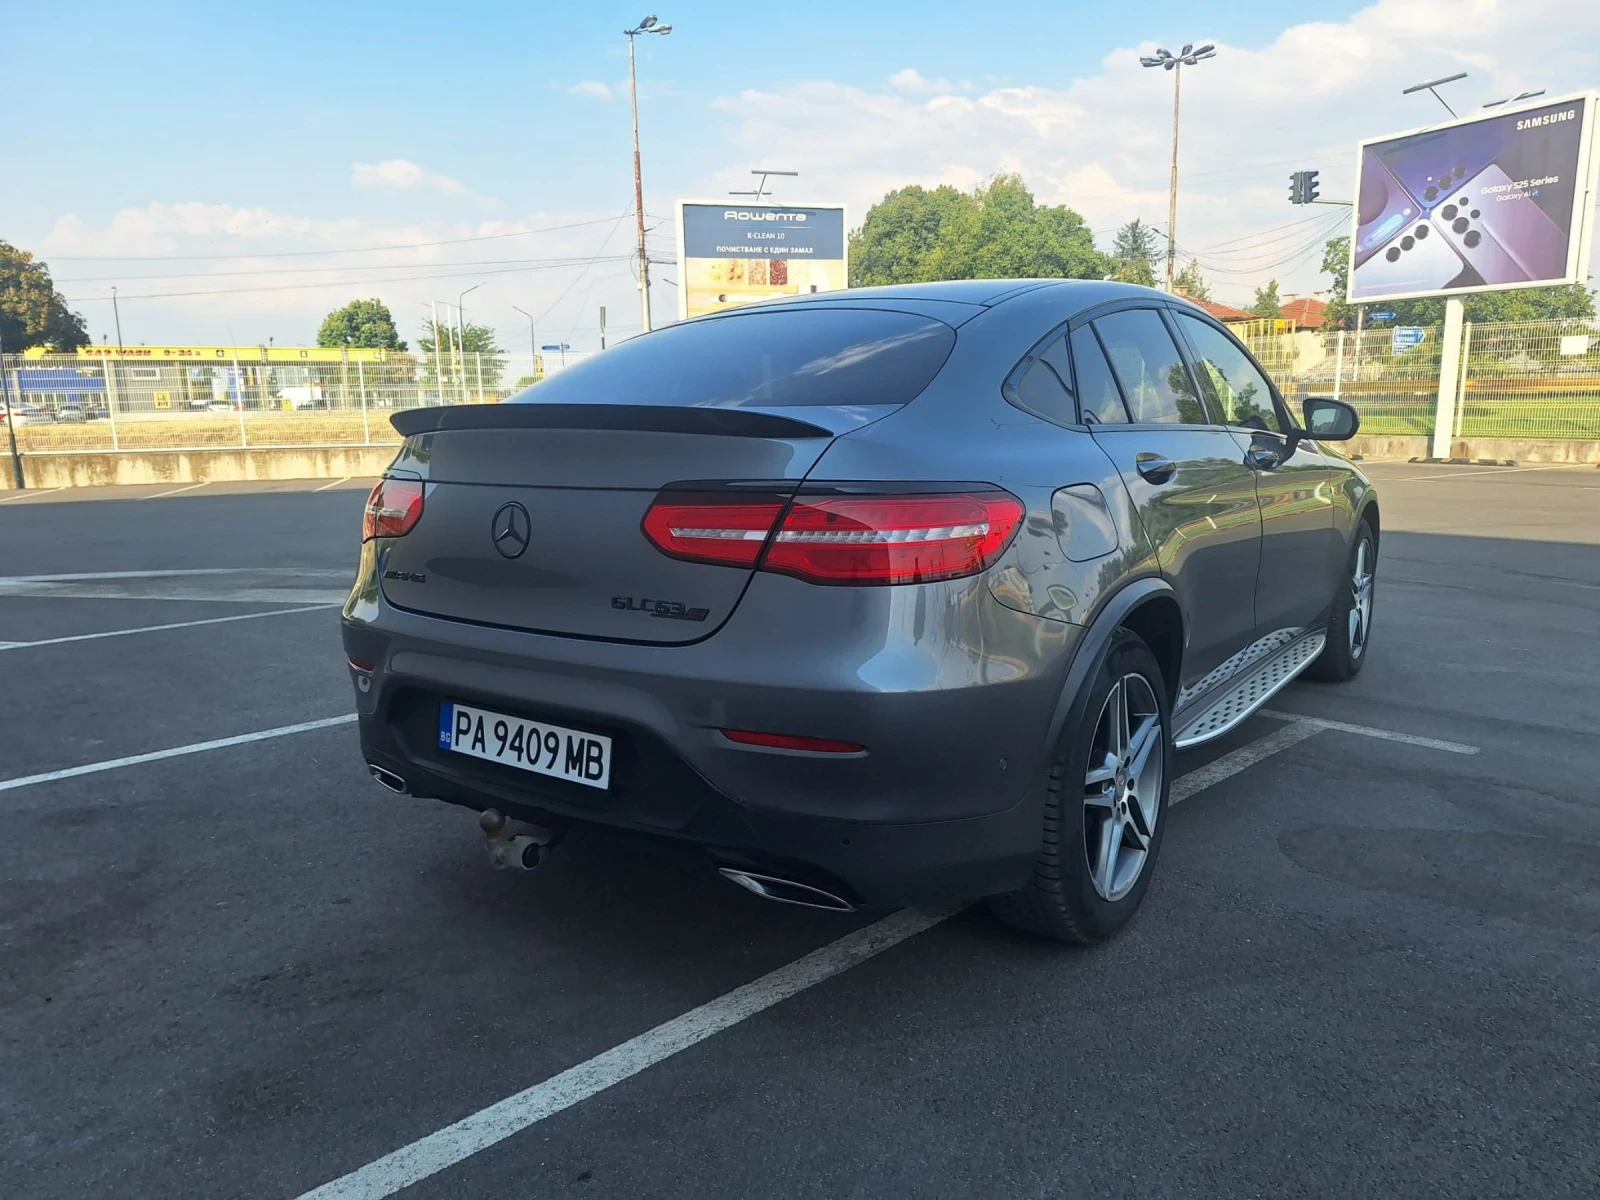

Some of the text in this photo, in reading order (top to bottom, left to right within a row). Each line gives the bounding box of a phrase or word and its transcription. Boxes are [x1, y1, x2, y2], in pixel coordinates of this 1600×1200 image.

[1516, 109, 1575, 131] SAMSUNG
[1480, 175, 1560, 195] Galaxy S25 Series
[1496, 192, 1523, 202] Galaxy
[746, 232, 785, 240] X-CLEAN 10
[611, 596, 686, 616] GLC63
[440, 731, 451, 743] BG
[455, 710, 604, 781] PA 9409 MB
